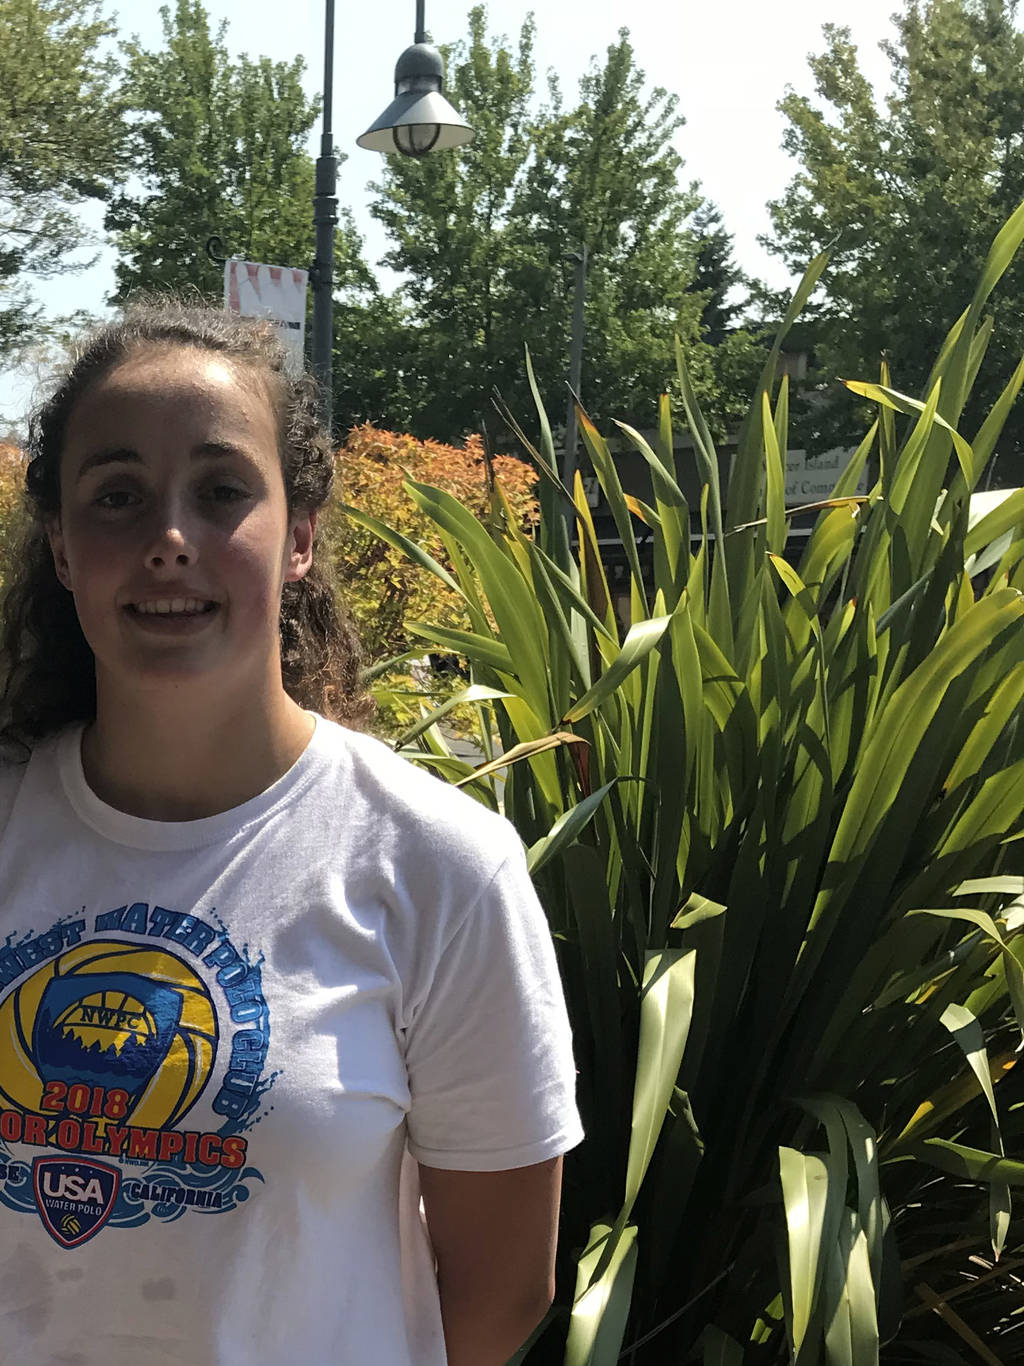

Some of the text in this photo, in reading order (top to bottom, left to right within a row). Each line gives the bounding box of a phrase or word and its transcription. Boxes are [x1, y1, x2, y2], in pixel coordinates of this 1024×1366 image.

[94, 902, 216, 957] WATER
[202, 940, 263, 1023] POLO
[80, 1006, 142, 1029] NWPC
[212, 1028, 264, 1119] CLUB
[40, 1080, 129, 1119] 2018
[56, 1118, 248, 1169] OLYMPICS
[43, 1171, 104, 1204] USA
[131, 1183, 223, 1208] CALIFORNIA
[46, 1199, 102, 1216] WATER POLO
